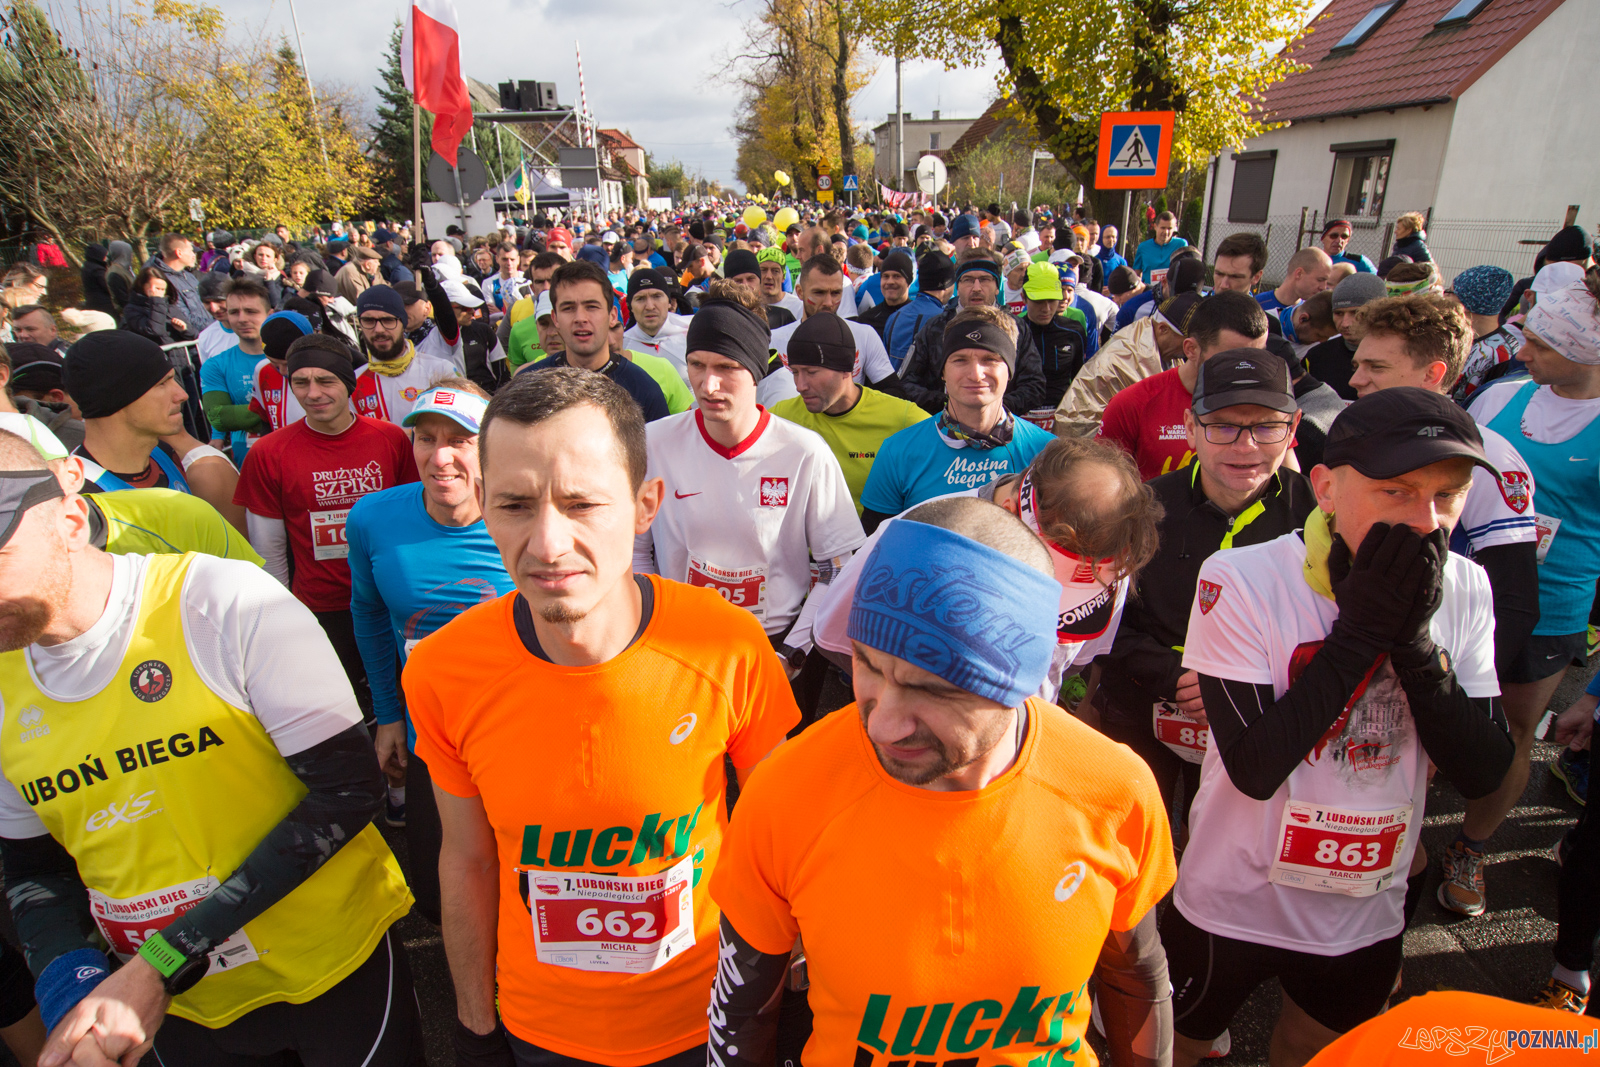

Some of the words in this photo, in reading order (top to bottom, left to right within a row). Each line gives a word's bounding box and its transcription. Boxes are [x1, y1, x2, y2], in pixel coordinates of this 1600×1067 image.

[819, 178, 830, 187] 30
[1416, 426, 1445, 437] 4F
[848, 451, 875, 459] WIKON
[312, 467, 371, 482] DRUŻYNA
[943, 456, 1008, 477] Mosina
[314, 476, 383, 499] SZPIKU
[947, 470, 986, 488] biega
[702, 563, 708, 571] 7.
[707, 565, 738, 578] LUBOŃSKI
[738, 569, 753, 578] BIEG
[913, 643, 938, 667] Z
[20, 724, 50, 743] errea
[115, 726, 225, 774] BIEGA
[131, 807, 164, 823] SPORT
[1315, 810, 1325, 823] 7.
[1326, 812, 1375, 826] LUBOŃSKI
[1377, 814, 1395, 825] BIEG
[520, 800, 705, 868] Lucky
[1324, 822, 1381, 834] Niepodległości
[1383, 825, 1403, 834] 11.11.2017
[1283, 836, 1292, 857] STREFA
[1314, 839, 1382, 868] 863
[1329, 870, 1363, 880] MARCIN
[564, 878, 575, 891] 7.
[576, 877, 634, 893] LUBOŃSKI
[637, 878, 664, 892] BIEG
[652, 883, 682, 901] 11.11.2017
[105, 901, 113, 915] 7.
[109, 896, 159, 915] LUBOŃSKI
[158, 889, 188, 905] BIEG
[577, 889, 644, 901] Niepodległości
[113, 906, 171, 921] Niepodległości
[541, 911, 549, 936] STREFA
[576, 908, 657, 938] 662
[601, 942, 638, 951] MICHAŁ
[856, 981, 1088, 1057] Lucky
